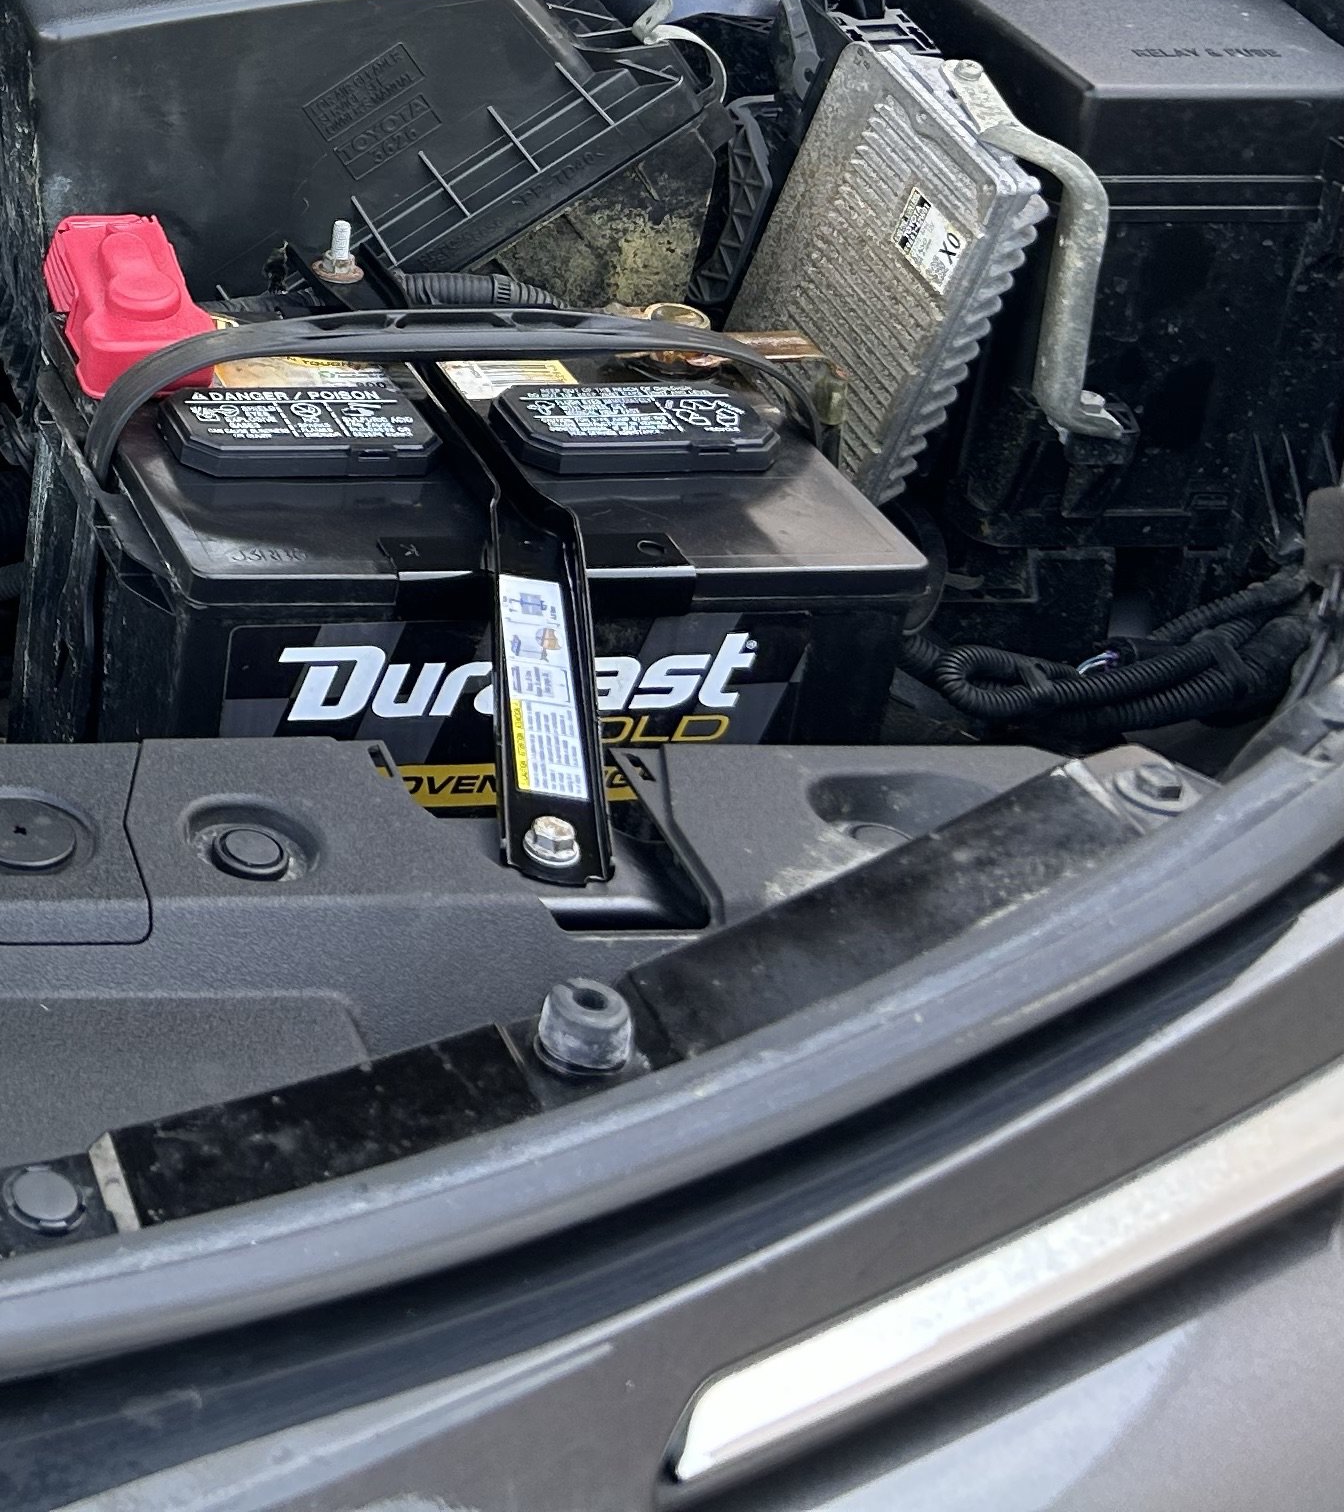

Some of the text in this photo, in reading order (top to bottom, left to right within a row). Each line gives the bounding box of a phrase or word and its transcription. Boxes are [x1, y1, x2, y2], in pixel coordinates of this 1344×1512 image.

[1131, 48, 1200, 57] RELAY
[1224, 48, 1282, 57] FUSE
[336, 94, 430, 163] TOYOTA
[209, 392, 289, 401] DANGER
[307, 391, 381, 400] POISON
[279, 632, 756, 721] Durast
[600, 715, 730, 743] OLD
